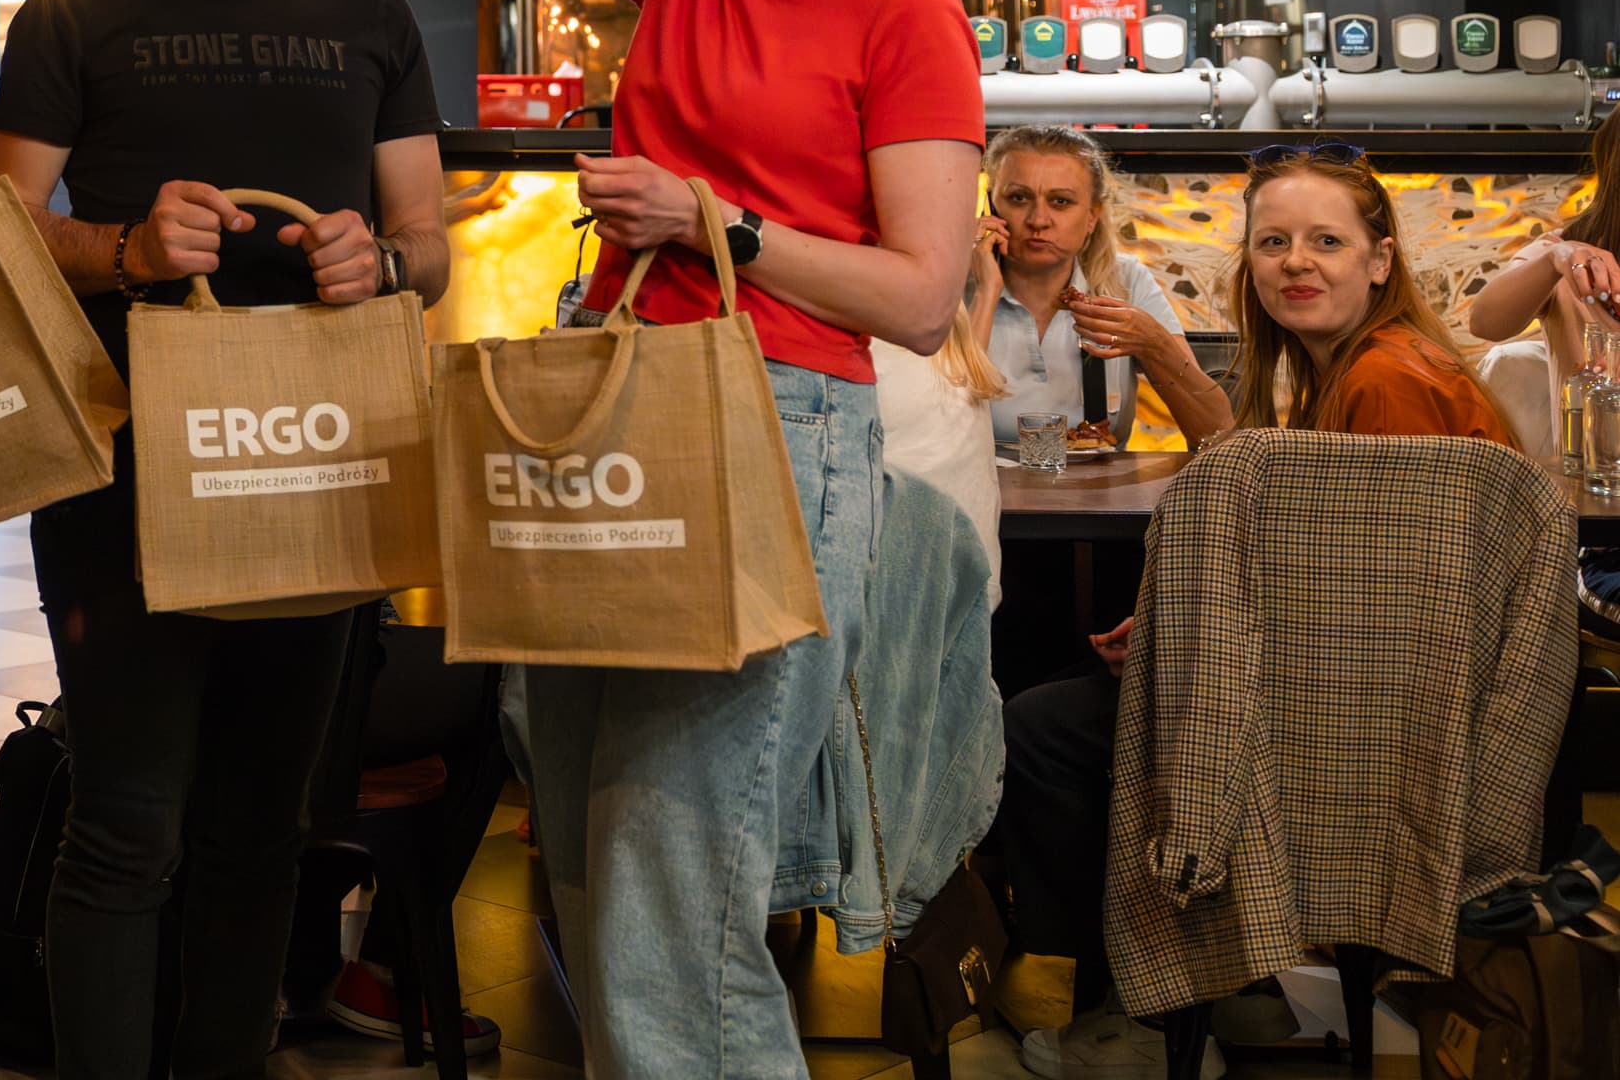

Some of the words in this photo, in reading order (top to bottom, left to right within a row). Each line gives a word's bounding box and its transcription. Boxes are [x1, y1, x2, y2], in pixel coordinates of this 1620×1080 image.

[133, 32, 243, 70] STONE
[251, 34, 347, 72] GIANT
[186, 401, 351, 459] ERGO
[202, 473, 313, 493] Ubezpieczenia
[318, 466, 380, 485] Podróży
[484, 452, 645, 510] ERGO
[496, 527, 604, 546] Ubezpieczenia
[609, 527, 675, 545] Podróży
